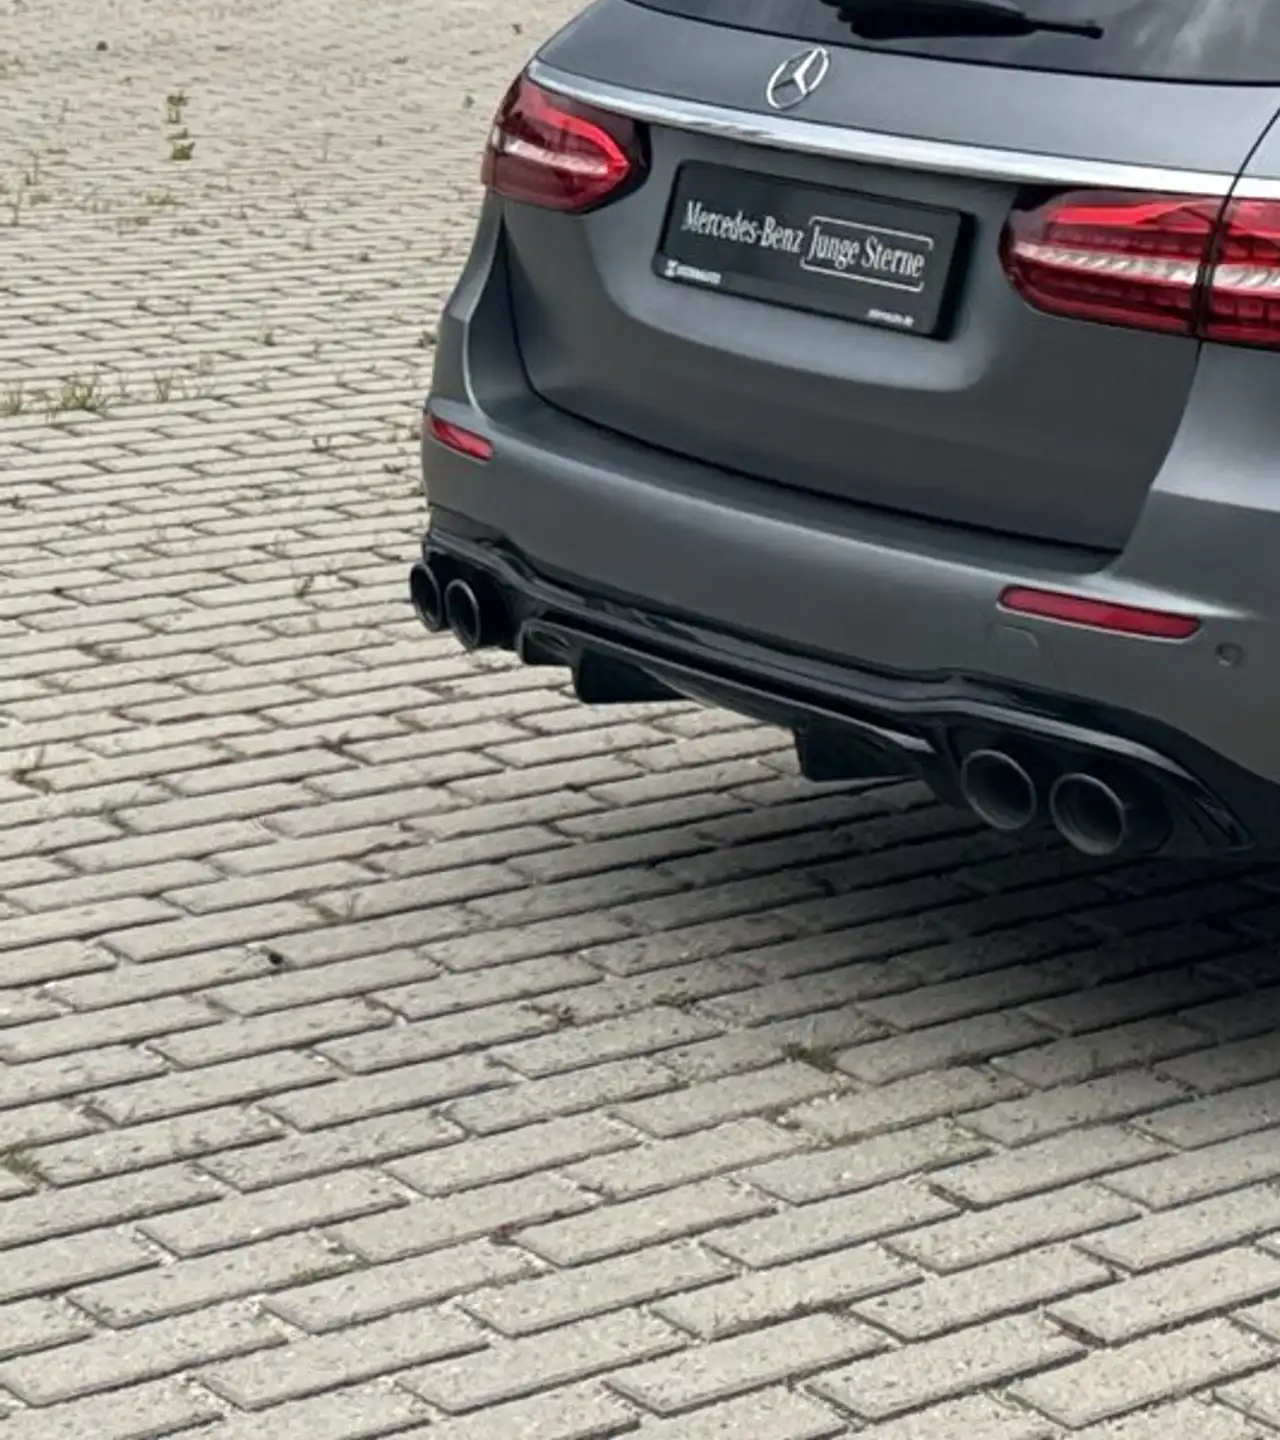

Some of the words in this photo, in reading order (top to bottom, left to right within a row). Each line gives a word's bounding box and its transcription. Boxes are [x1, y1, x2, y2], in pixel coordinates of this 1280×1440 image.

[681, 200, 805, 254] Mercedes-Benz
[807, 224, 860, 269] Junge
[861, 235, 925, 277] Sterne
